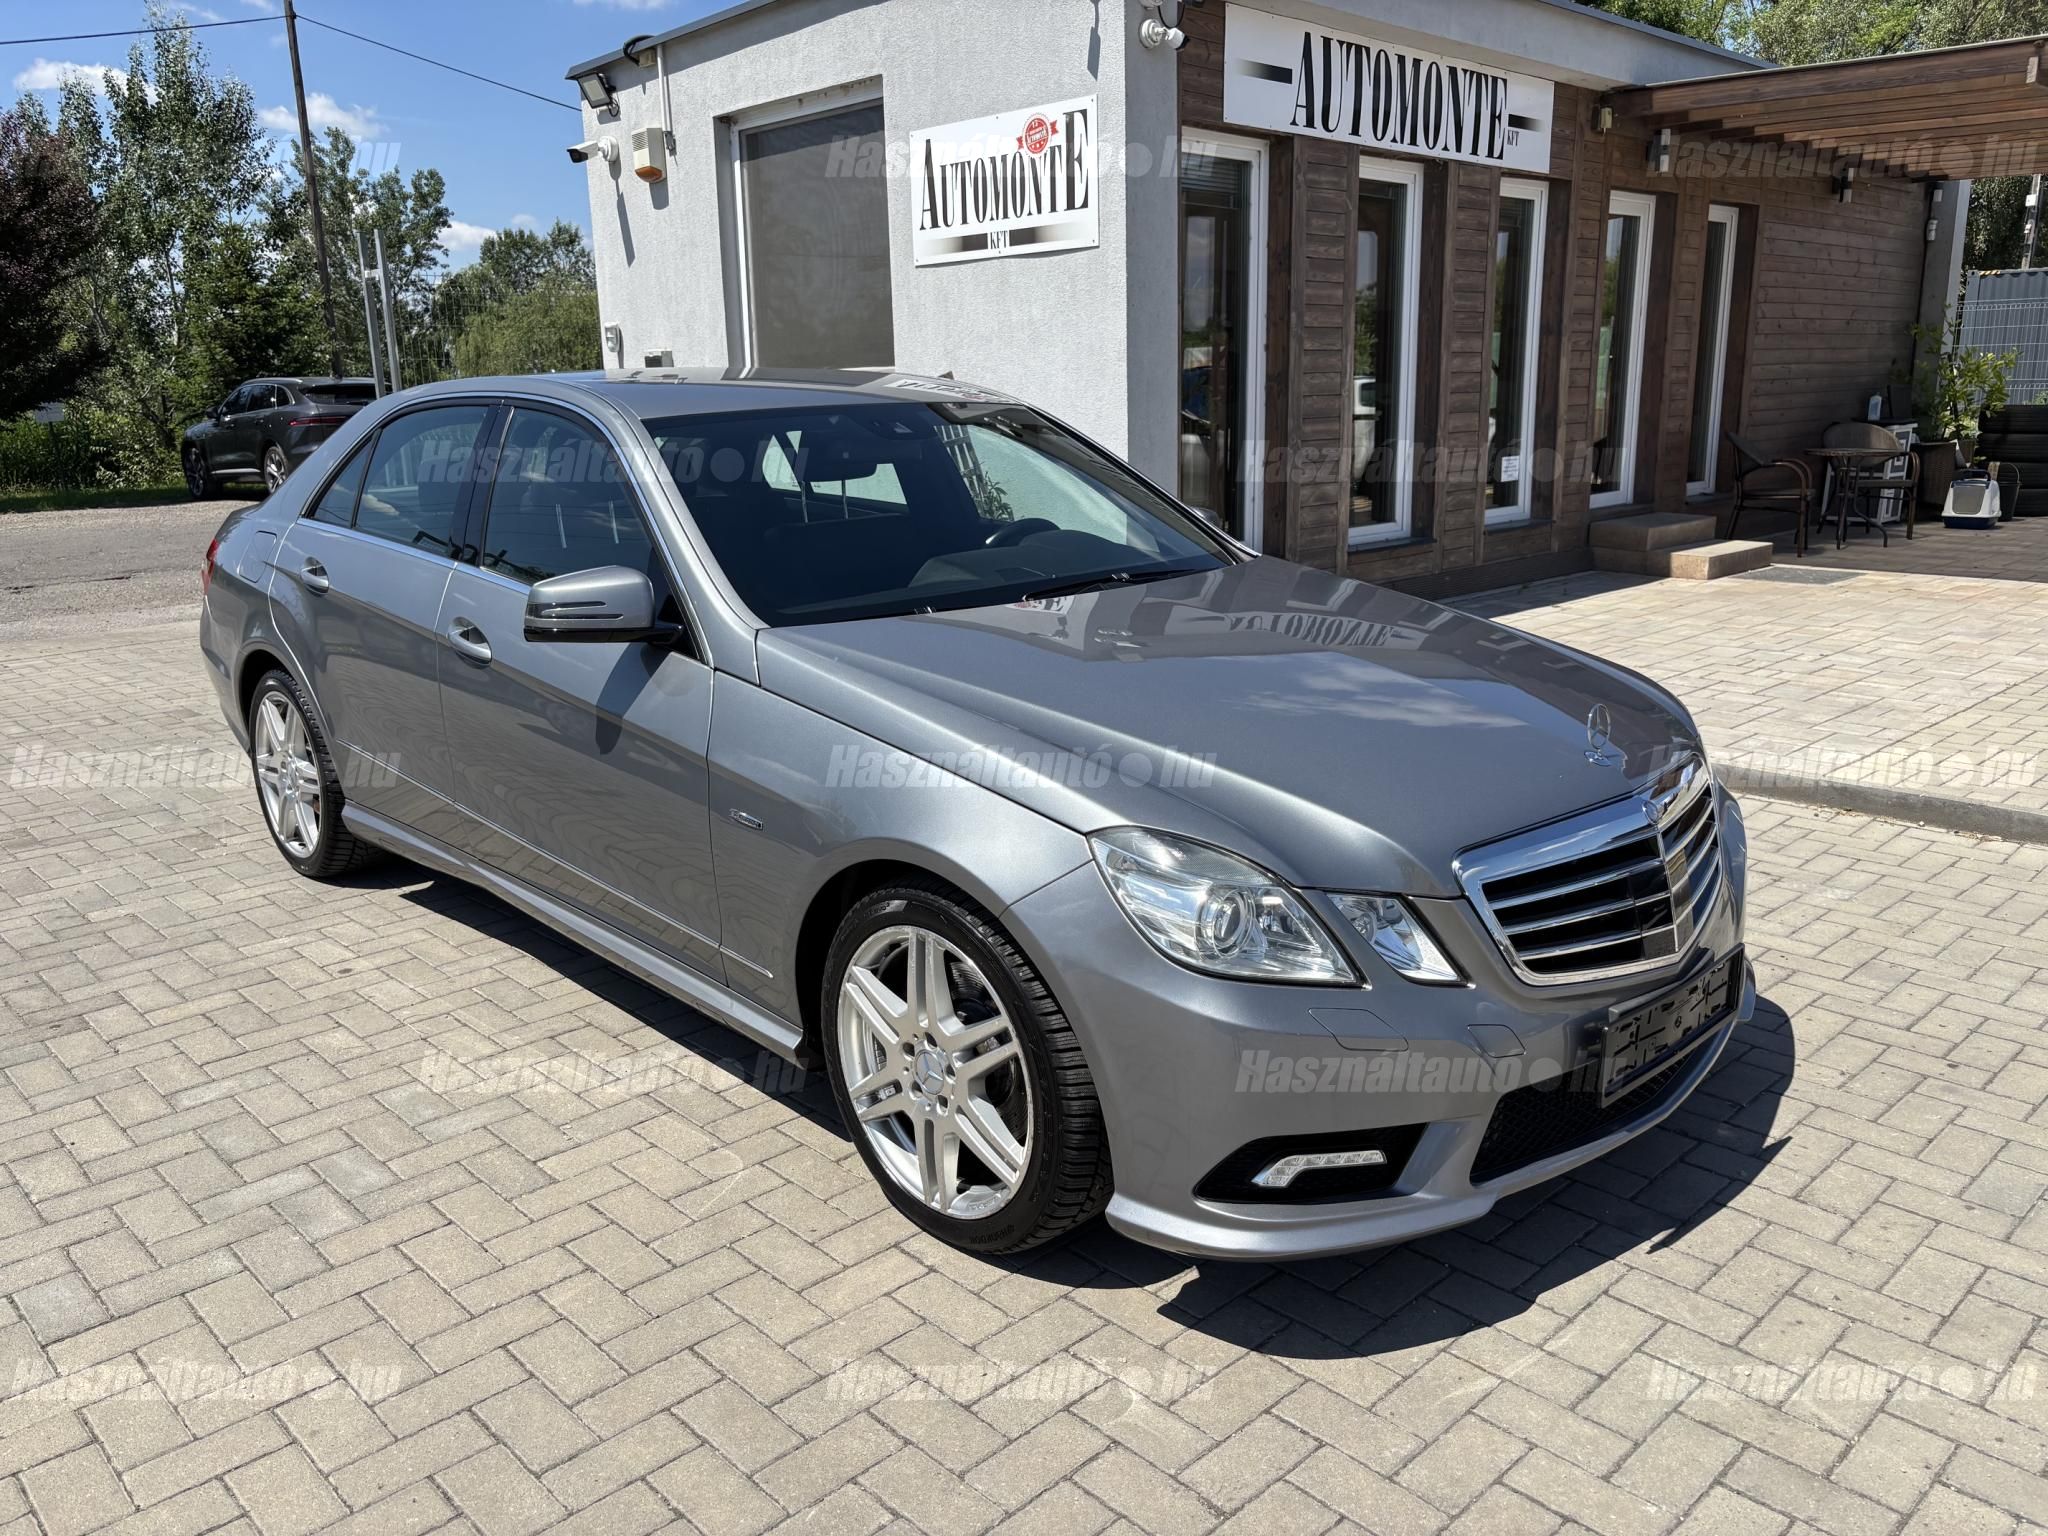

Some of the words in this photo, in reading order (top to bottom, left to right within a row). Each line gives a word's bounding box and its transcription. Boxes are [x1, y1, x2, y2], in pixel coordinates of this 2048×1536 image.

[1290, 32, 1507, 160] AUTOMONTE
[920, 109, 1089, 231] AUTOMONTE
[990, 230, 1009, 249] KFT
